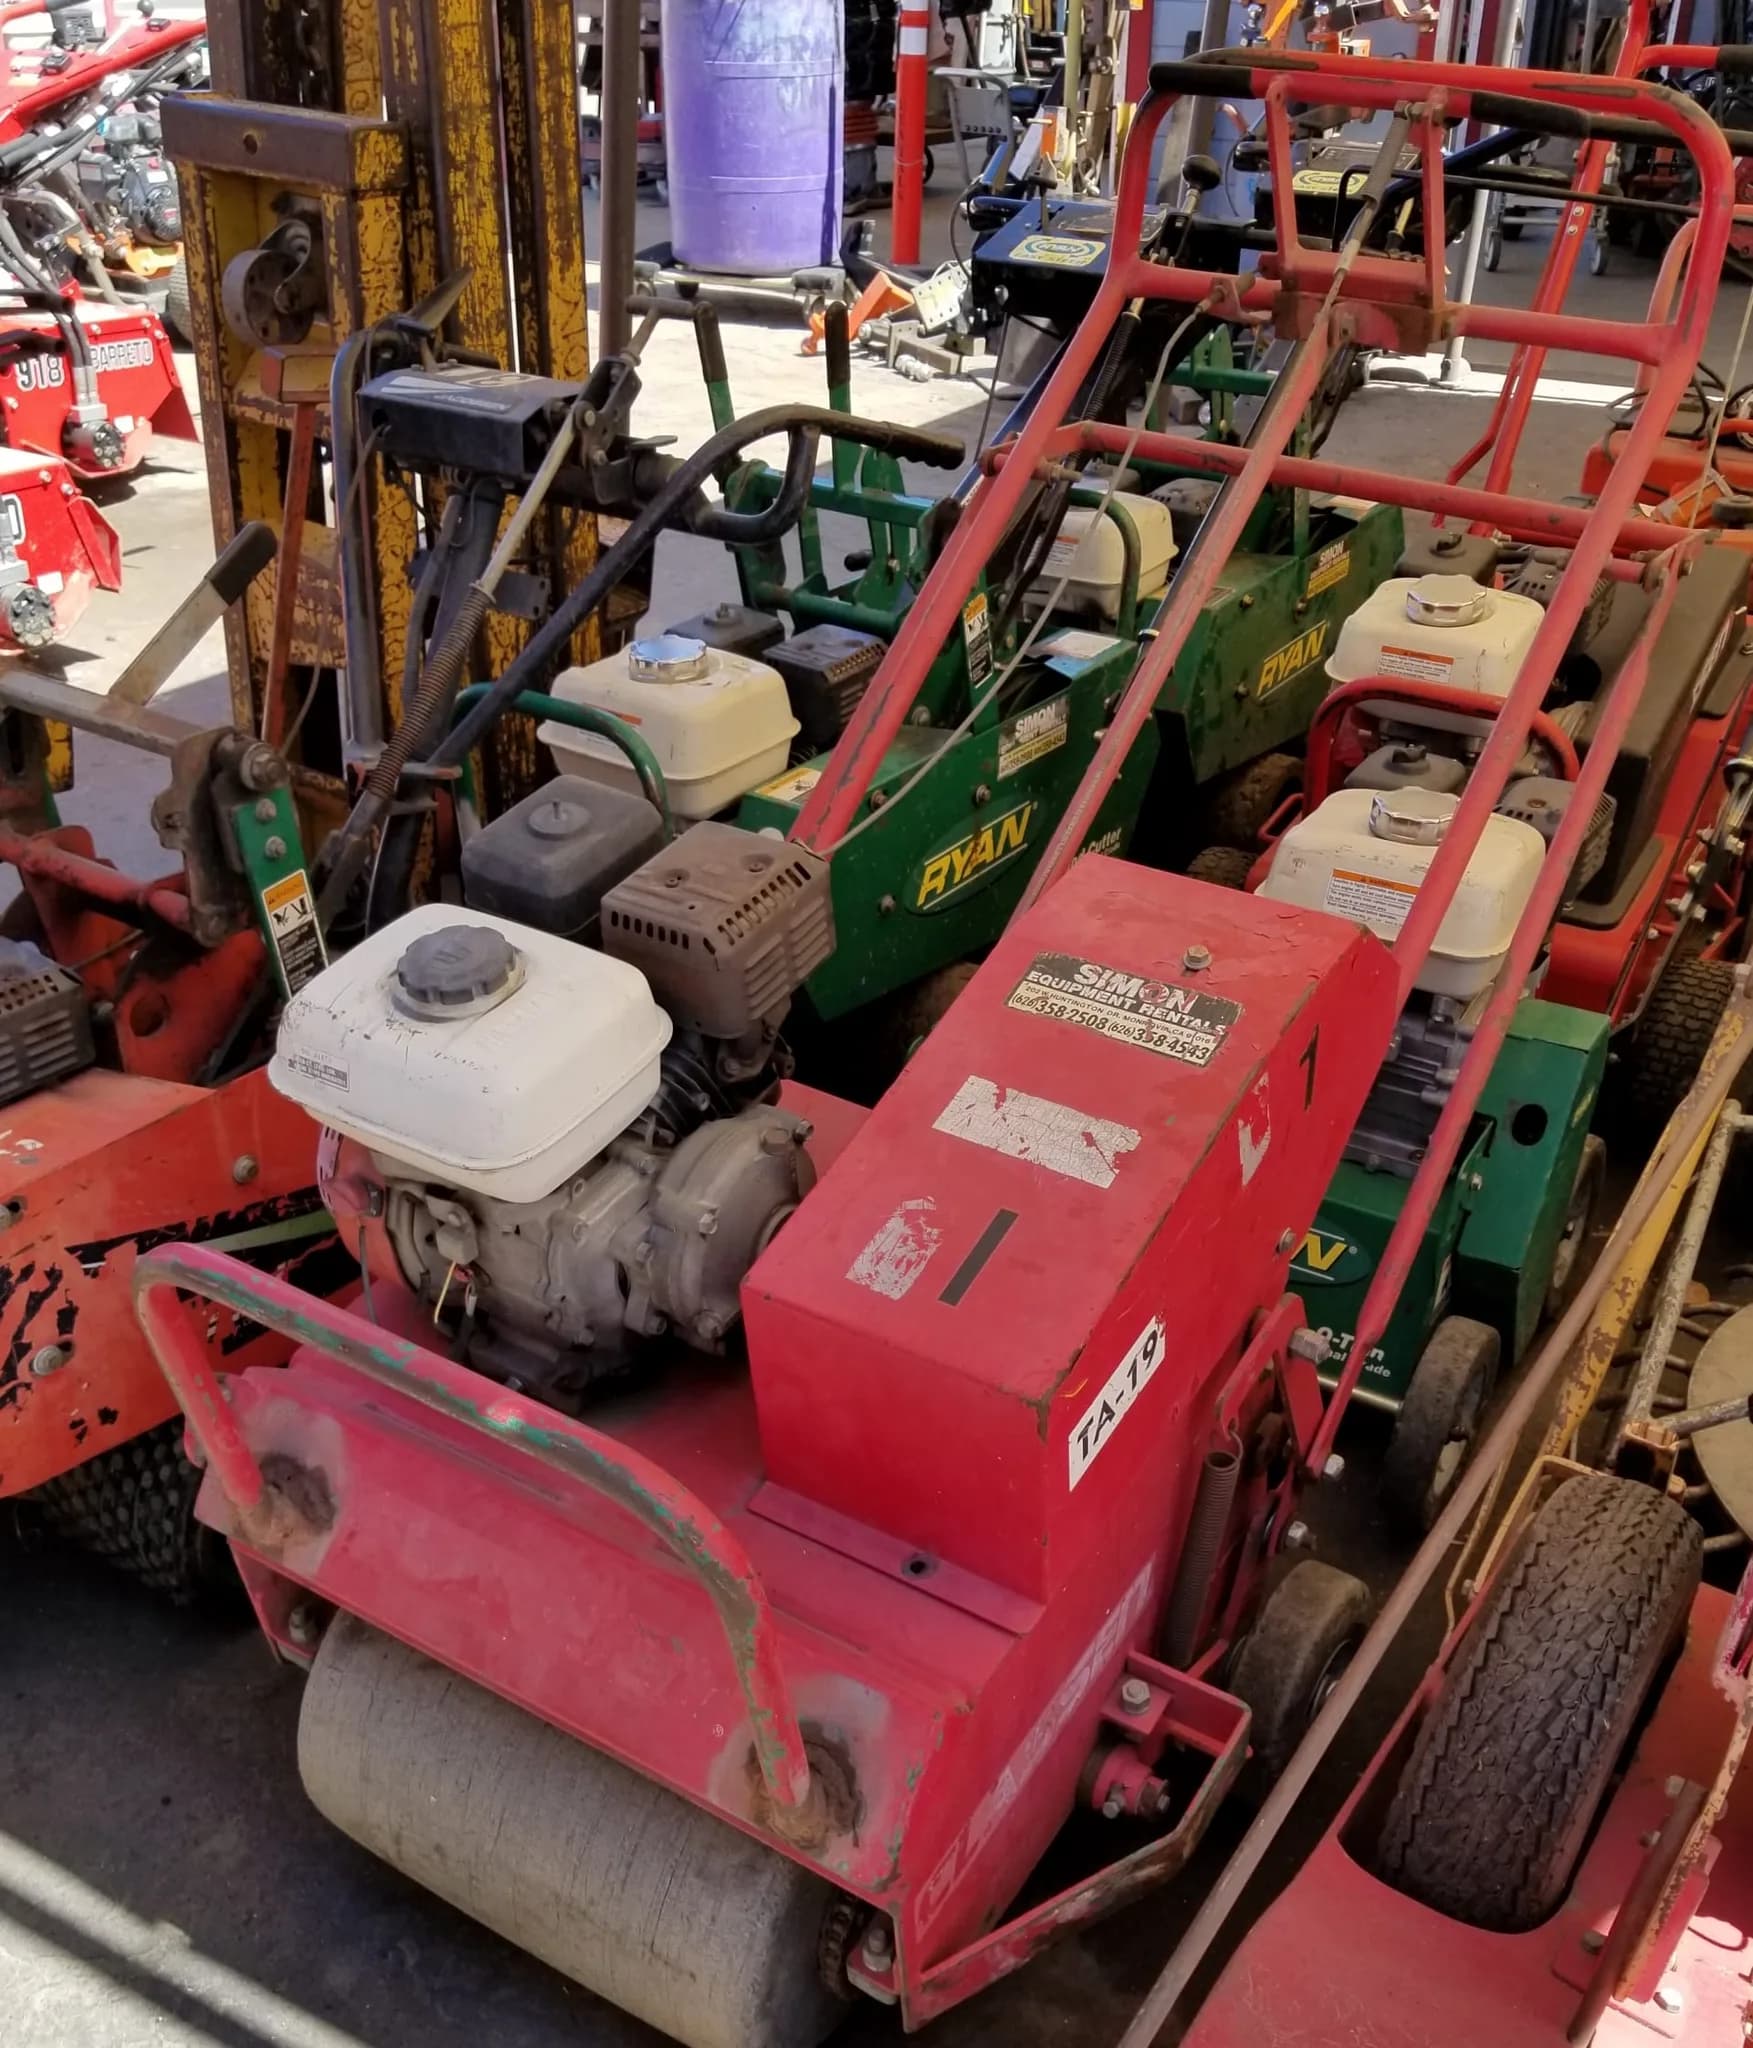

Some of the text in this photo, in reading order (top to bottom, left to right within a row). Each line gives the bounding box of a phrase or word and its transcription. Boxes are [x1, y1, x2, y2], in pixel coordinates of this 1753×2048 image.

[16, 354, 64, 391] 918
[1256, 623, 1327, 697] RYAN
[1015, 703, 1056, 738] SIMON
[917, 804, 1032, 907] RYAN
[1088, 827, 1123, 854] Cutter
[1026, 970, 1227, 1037] EQUIPMENT RENTALS
[1073, 963, 1200, 1014] SIMON
[1077, 1329, 1158, 1461] TA-19
